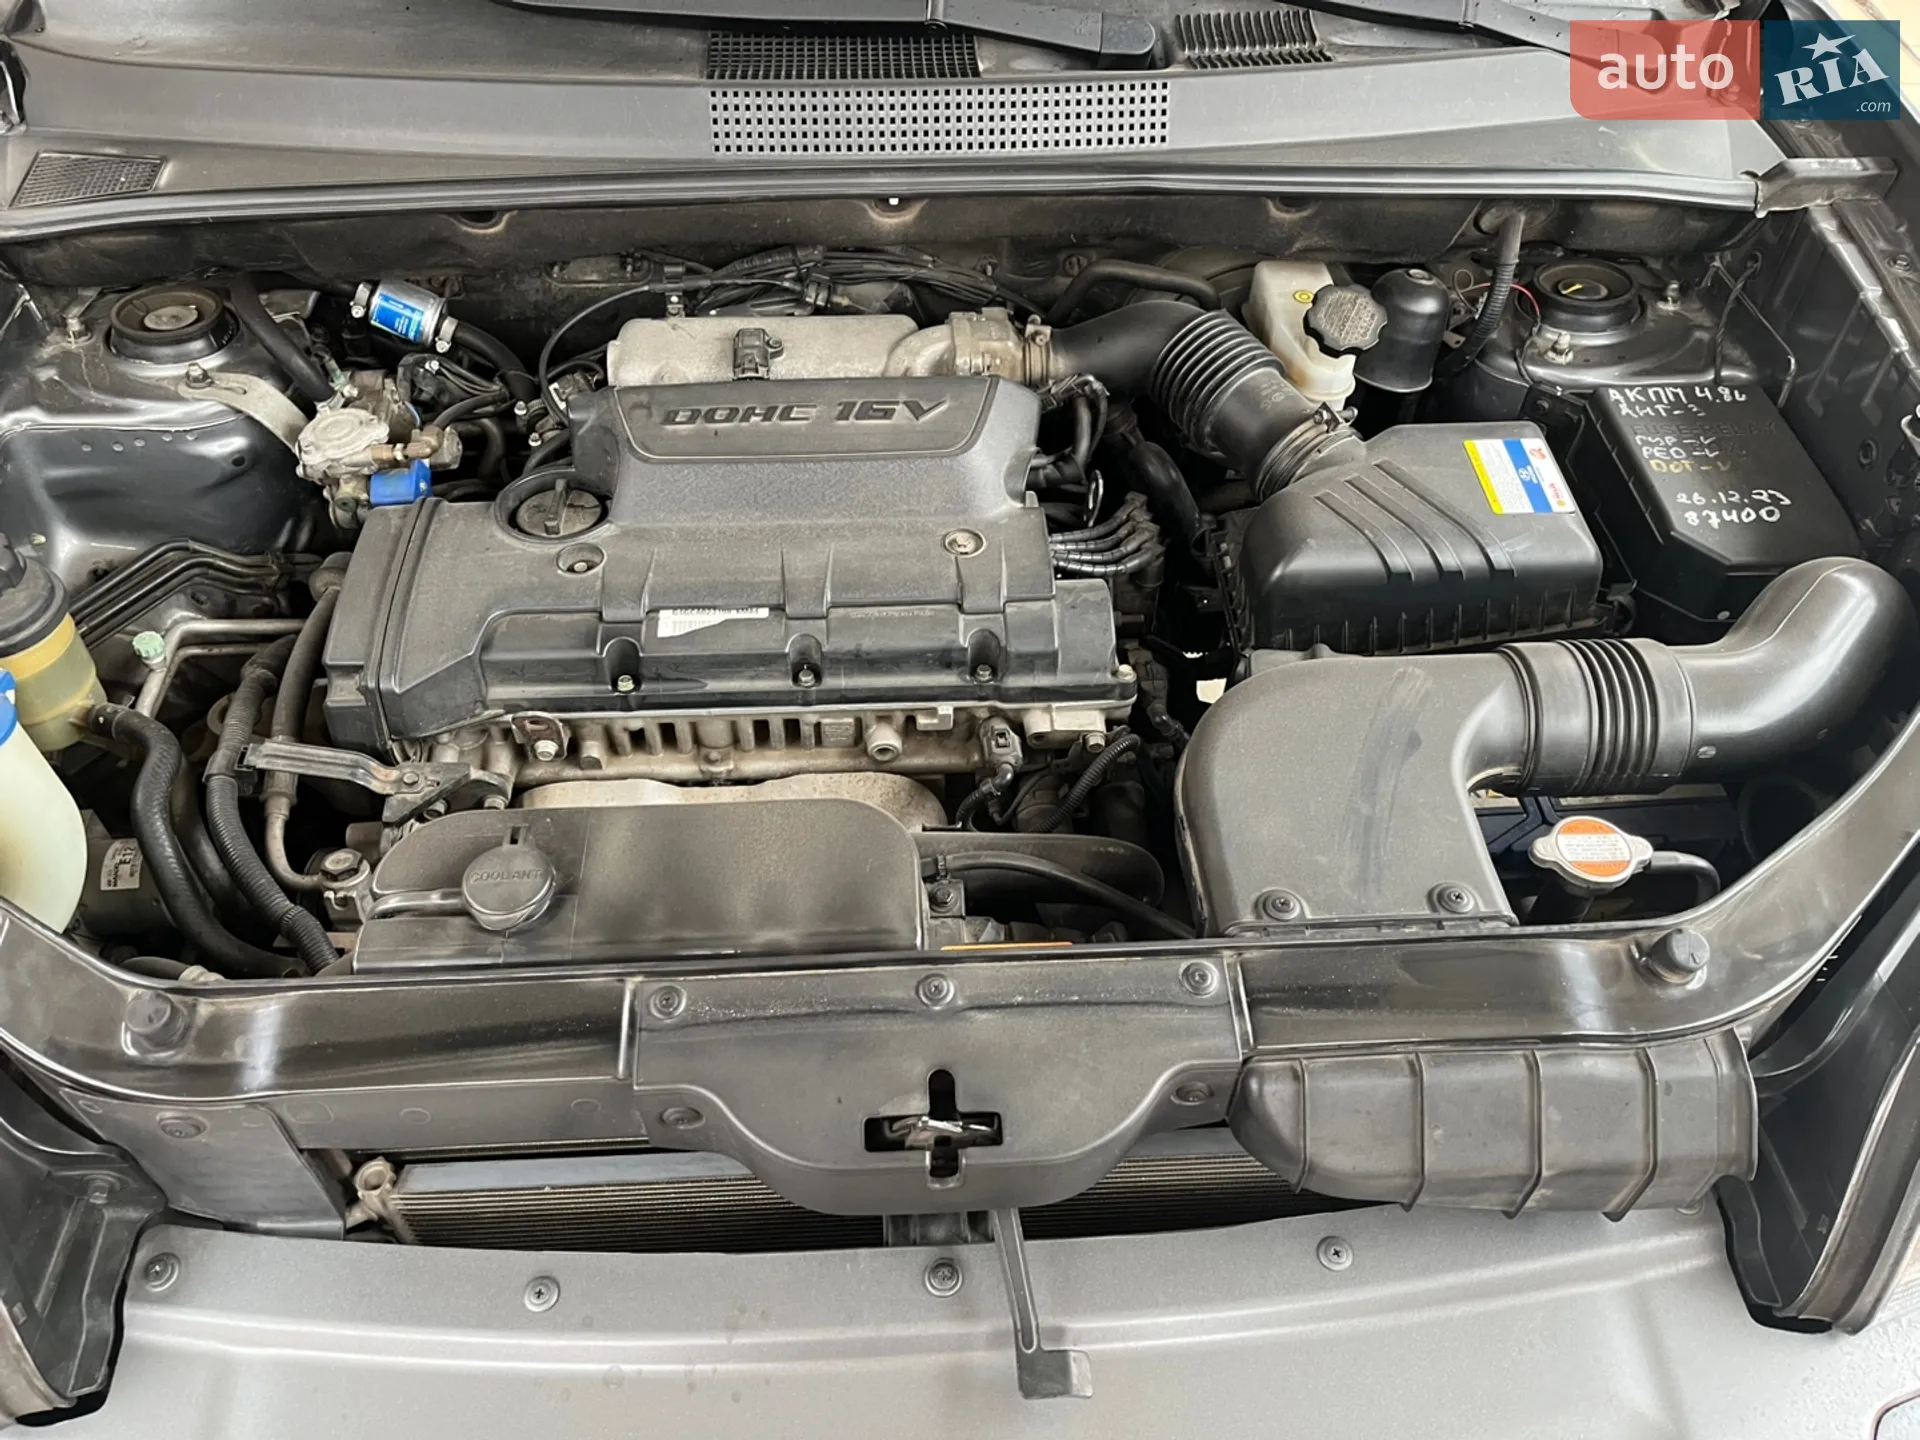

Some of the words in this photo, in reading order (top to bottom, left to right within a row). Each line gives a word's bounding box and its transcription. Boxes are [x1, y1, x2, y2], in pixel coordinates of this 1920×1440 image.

[661, 404, 817, 426] DOHC
[835, 398, 949, 422] 16V
[471, 869, 542, 882] COOLANT
